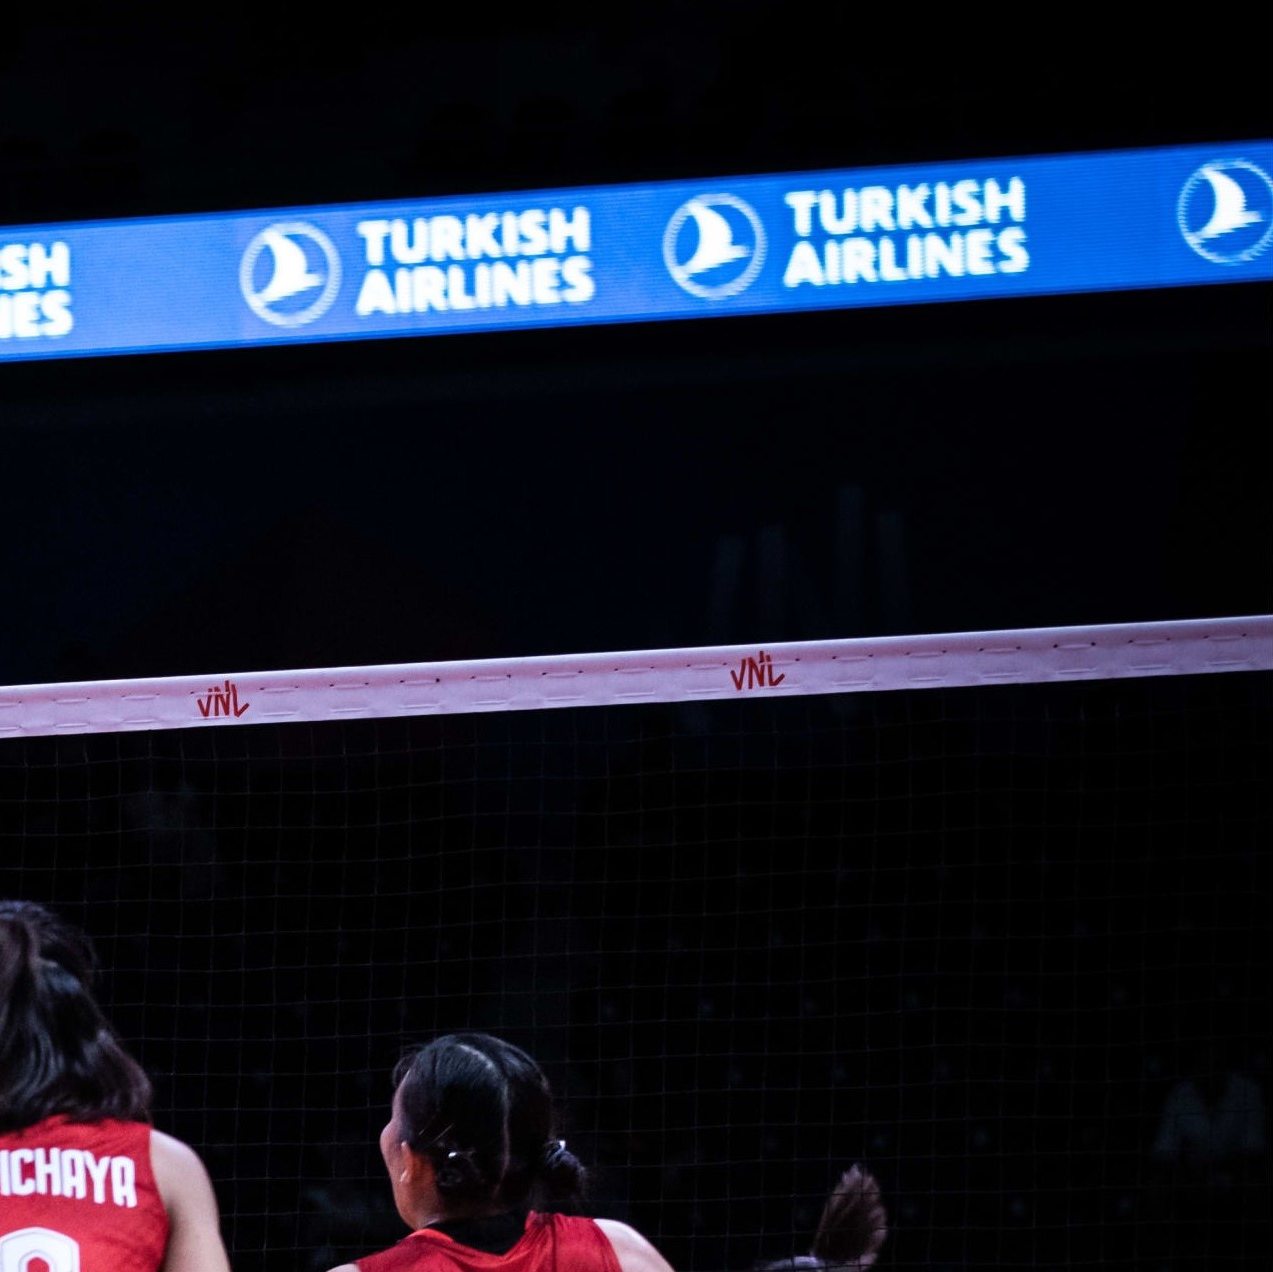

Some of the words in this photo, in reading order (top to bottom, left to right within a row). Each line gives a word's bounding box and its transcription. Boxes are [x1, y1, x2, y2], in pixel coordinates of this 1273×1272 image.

[356, 206, 591, 266] TURKISH
[785, 178, 1027, 236] TURKISH
[355, 256, 595, 316] AIRLINES
[783, 227, 1030, 287] AIRLINES
